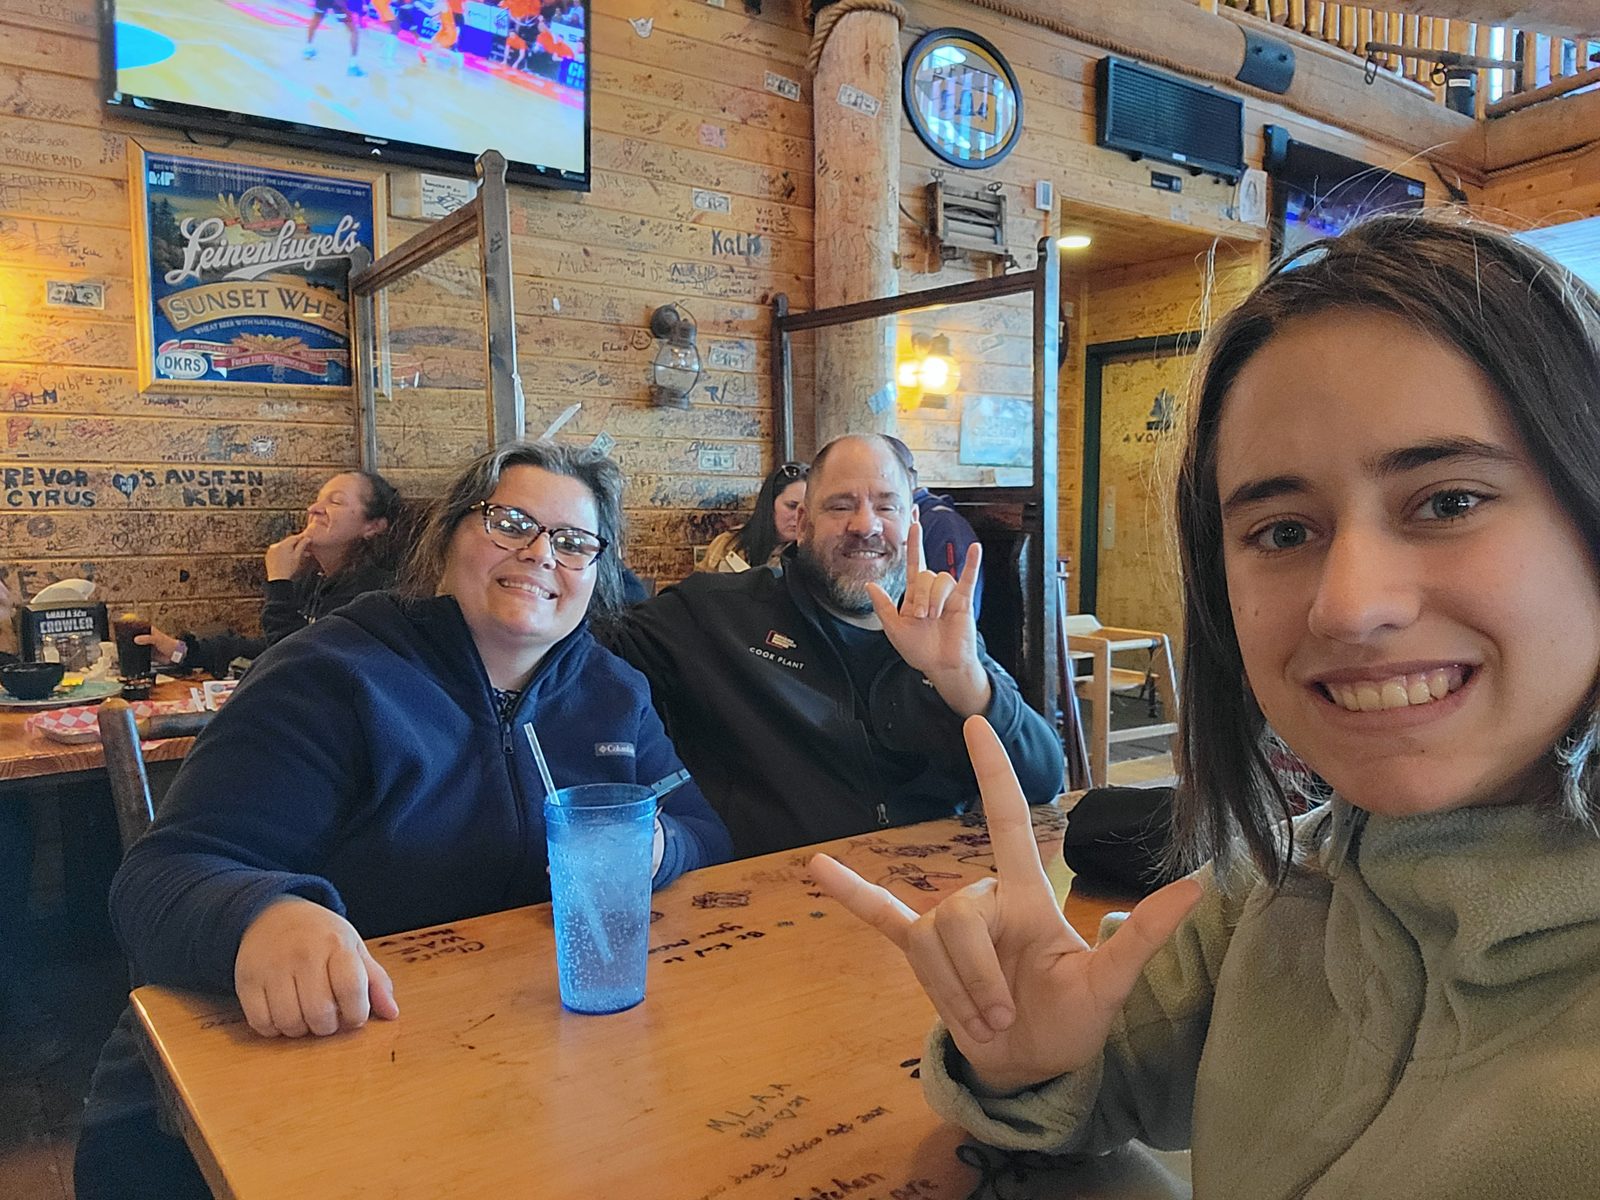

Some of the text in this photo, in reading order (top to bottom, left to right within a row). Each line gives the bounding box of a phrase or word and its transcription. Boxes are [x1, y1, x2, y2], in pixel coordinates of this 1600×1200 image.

[164, 215, 361, 285] Leinenkugel's
[168, 287, 350, 329] SUNSET WHEA
[164, 355, 202, 373] DKRS
[0, 467, 89, 490] REVOR
[165, 469, 263, 486] AUSTIN
[7, 489, 96, 507] CYRUS
[40, 616, 94, 634] CROWLER
[749, 646, 805, 670] COOK PLANT
